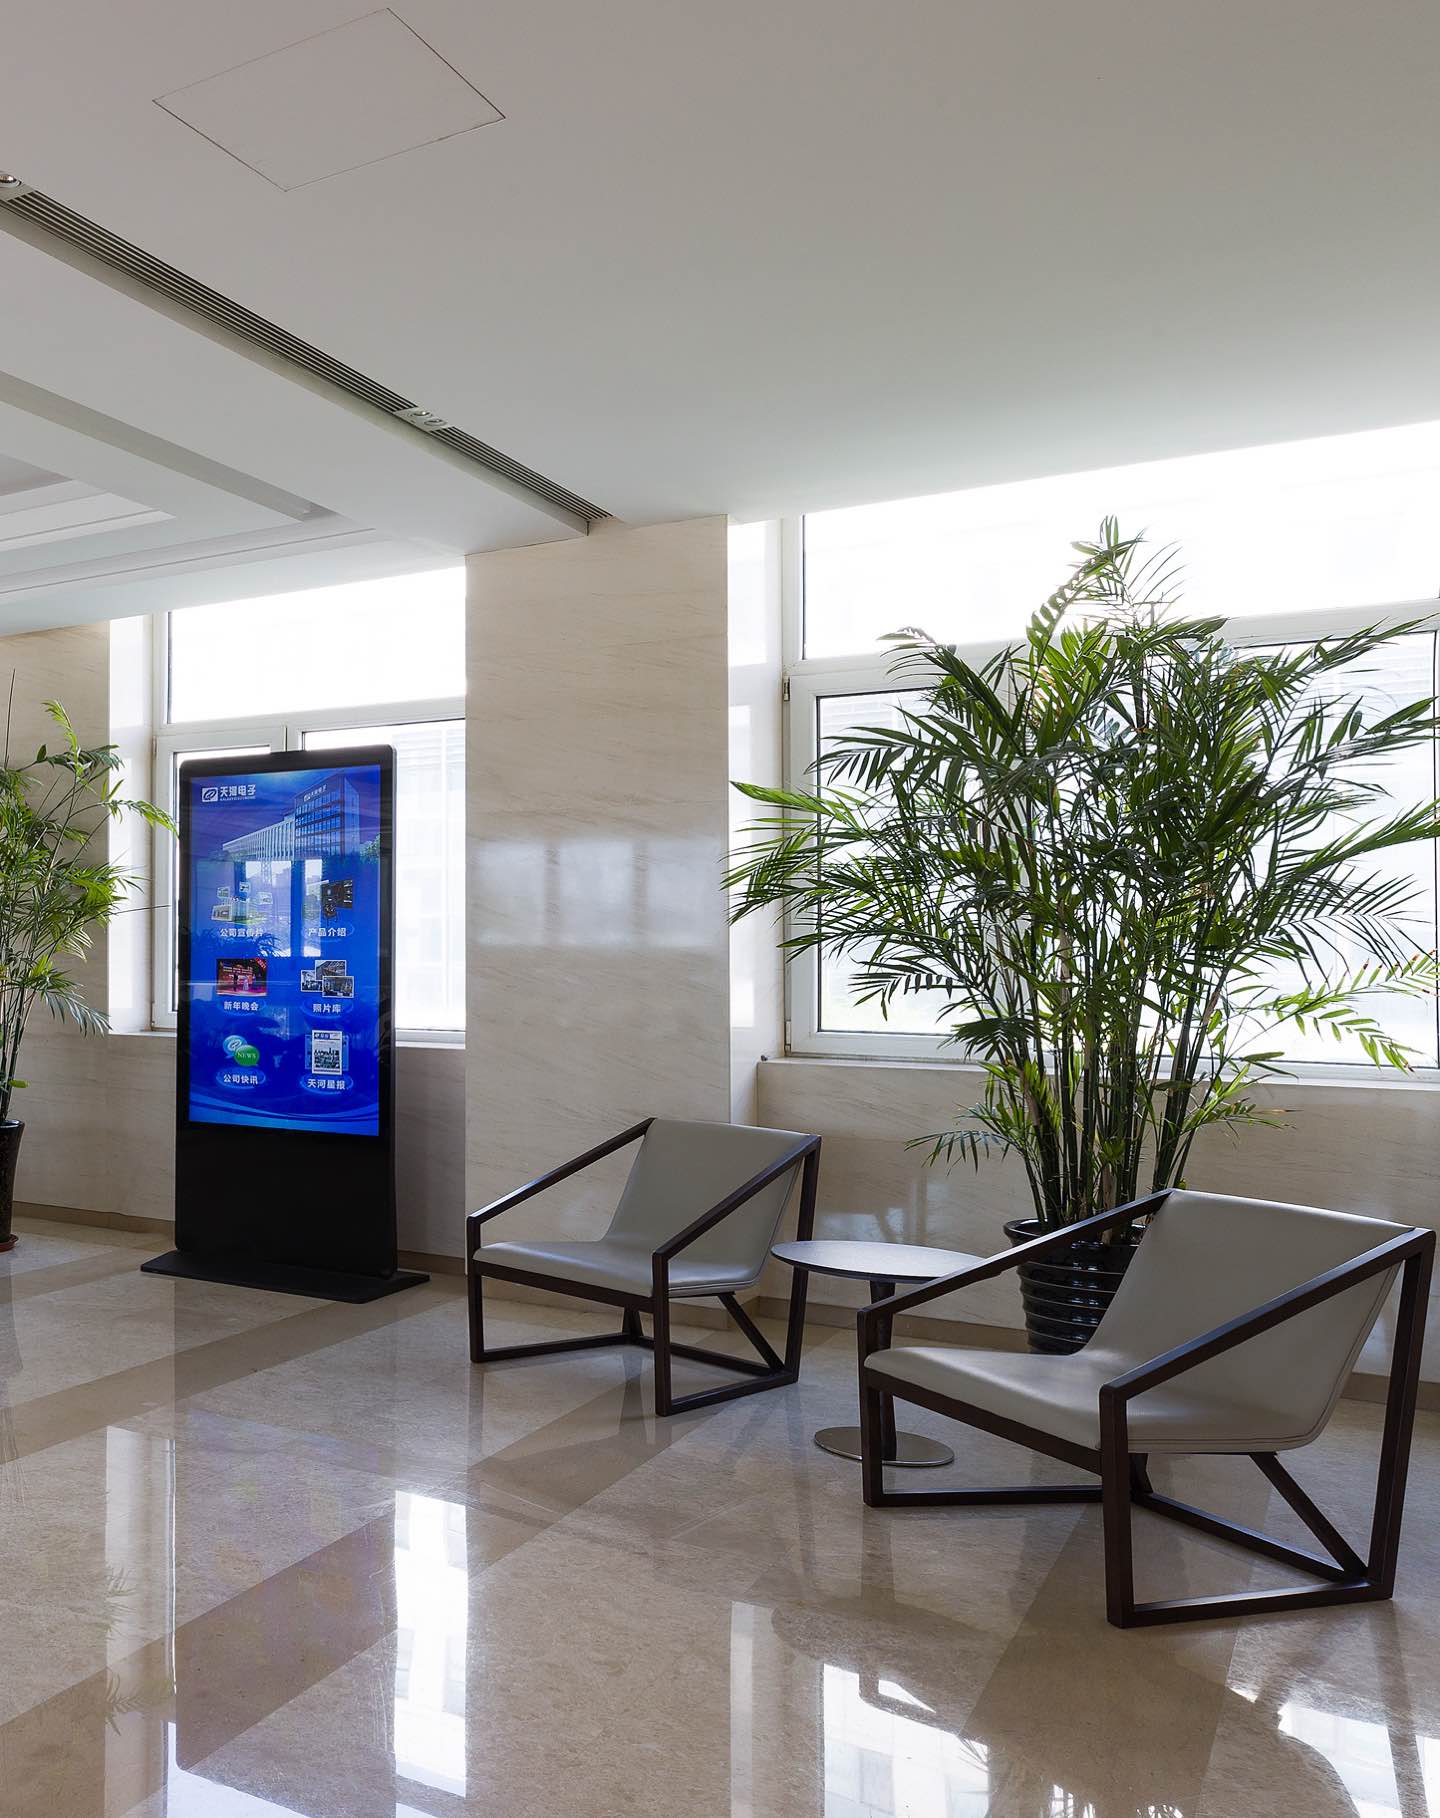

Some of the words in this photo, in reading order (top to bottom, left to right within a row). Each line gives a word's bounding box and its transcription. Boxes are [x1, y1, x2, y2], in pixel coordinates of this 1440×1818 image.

[308, 927, 346, 937] 产品介绍
[223, 1001, 259, 1011] 新年晚会
[312, 1003, 341, 1014] 照片库
[223, 1074, 258, 1085] 公司快讯
[307, 1078, 345, 1090] 天河星报
